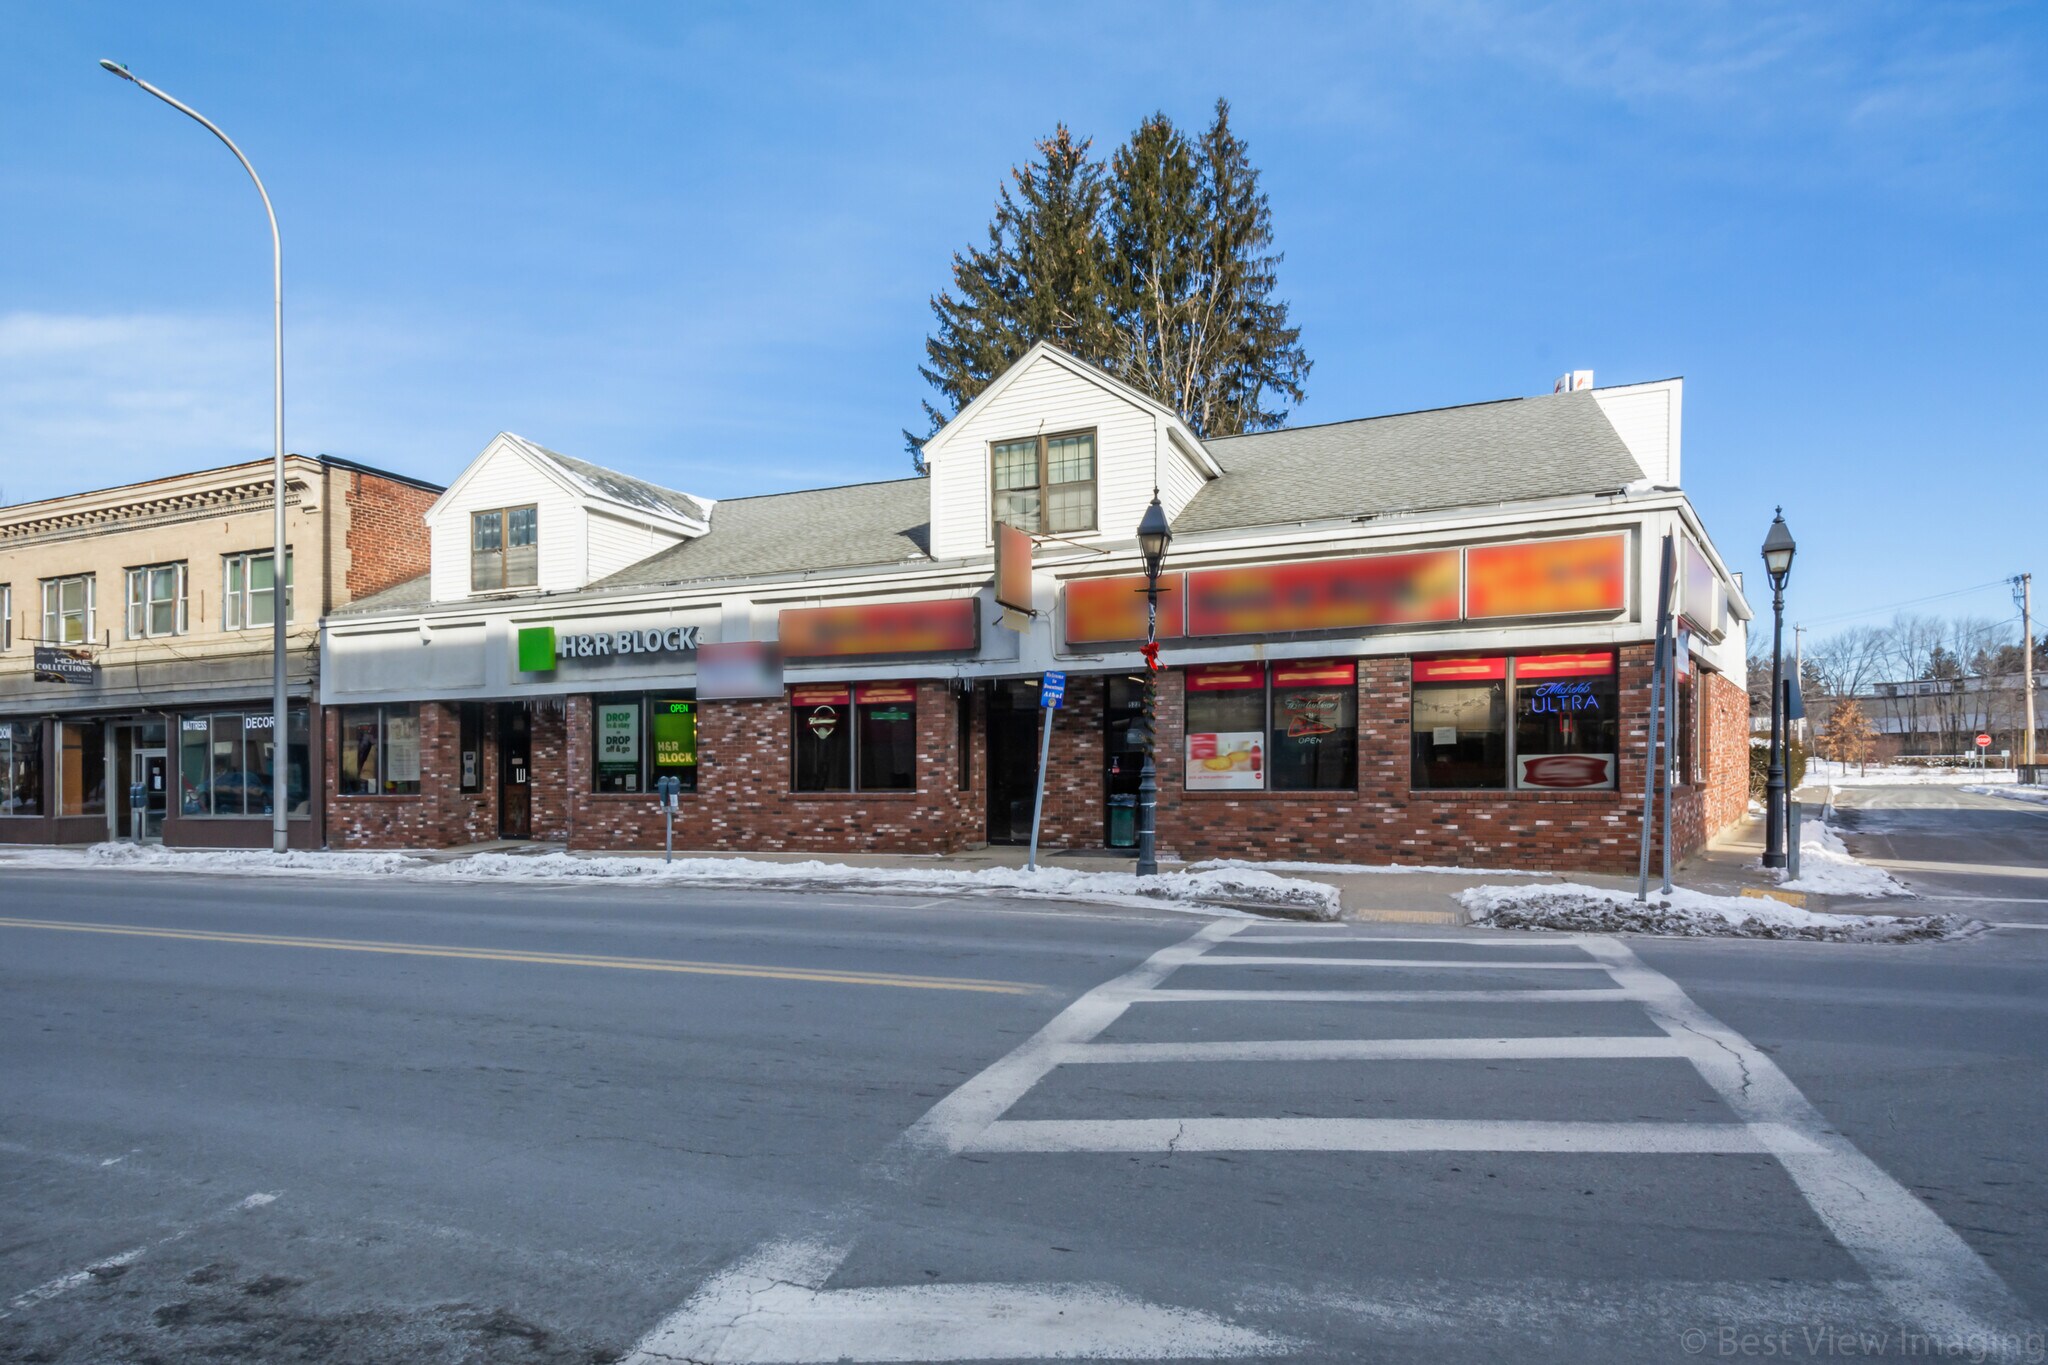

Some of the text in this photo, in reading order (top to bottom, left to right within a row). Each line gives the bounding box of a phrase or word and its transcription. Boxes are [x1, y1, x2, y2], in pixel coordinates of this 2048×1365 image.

[562, 626, 699, 658] H&R BLOCK
[54, 657, 91, 665] HOME
[36, 663, 92, 673] COLLECTIONS
[1044, 691, 1062, 699] Athol
[670, 703, 688, 713] OPEN
[1531, 694, 1600, 713] ULTRA
[606, 712, 630, 722] DROP
[182, 720, 207, 731] MATTRESS
[245, 716, 275, 729] DECOR
[606, 735, 630, 745] DROP
[1297, 736, 1323, 745] OPEN
[657, 741, 679, 751] H&R
[658, 753, 692, 762] BLOCK
